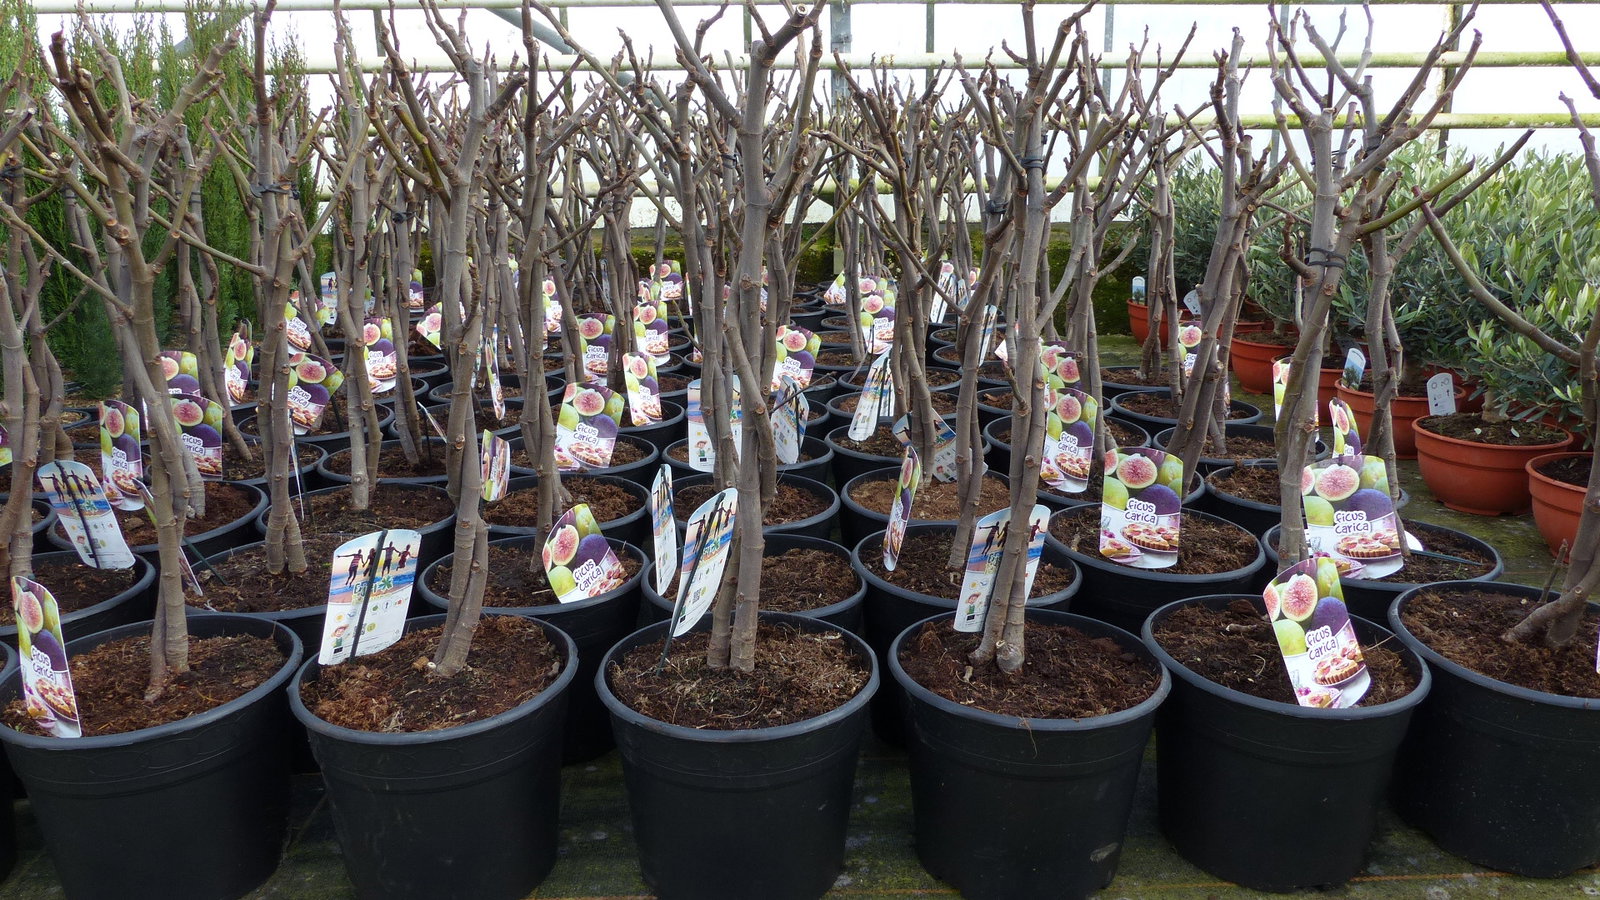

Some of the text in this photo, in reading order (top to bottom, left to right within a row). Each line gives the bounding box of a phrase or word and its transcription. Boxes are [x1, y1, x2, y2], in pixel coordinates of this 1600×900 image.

[1128, 500, 1154, 513] ficus
[1124, 511, 1156, 524] carica
[1335, 512, 1364, 523] ficus
[1334, 522, 1369, 534] carica
[574, 560, 595, 581] ficus
[579, 567, 602, 592] carica
[1306, 628, 1330, 646] ficus
[1308, 639, 1336, 660] carica
